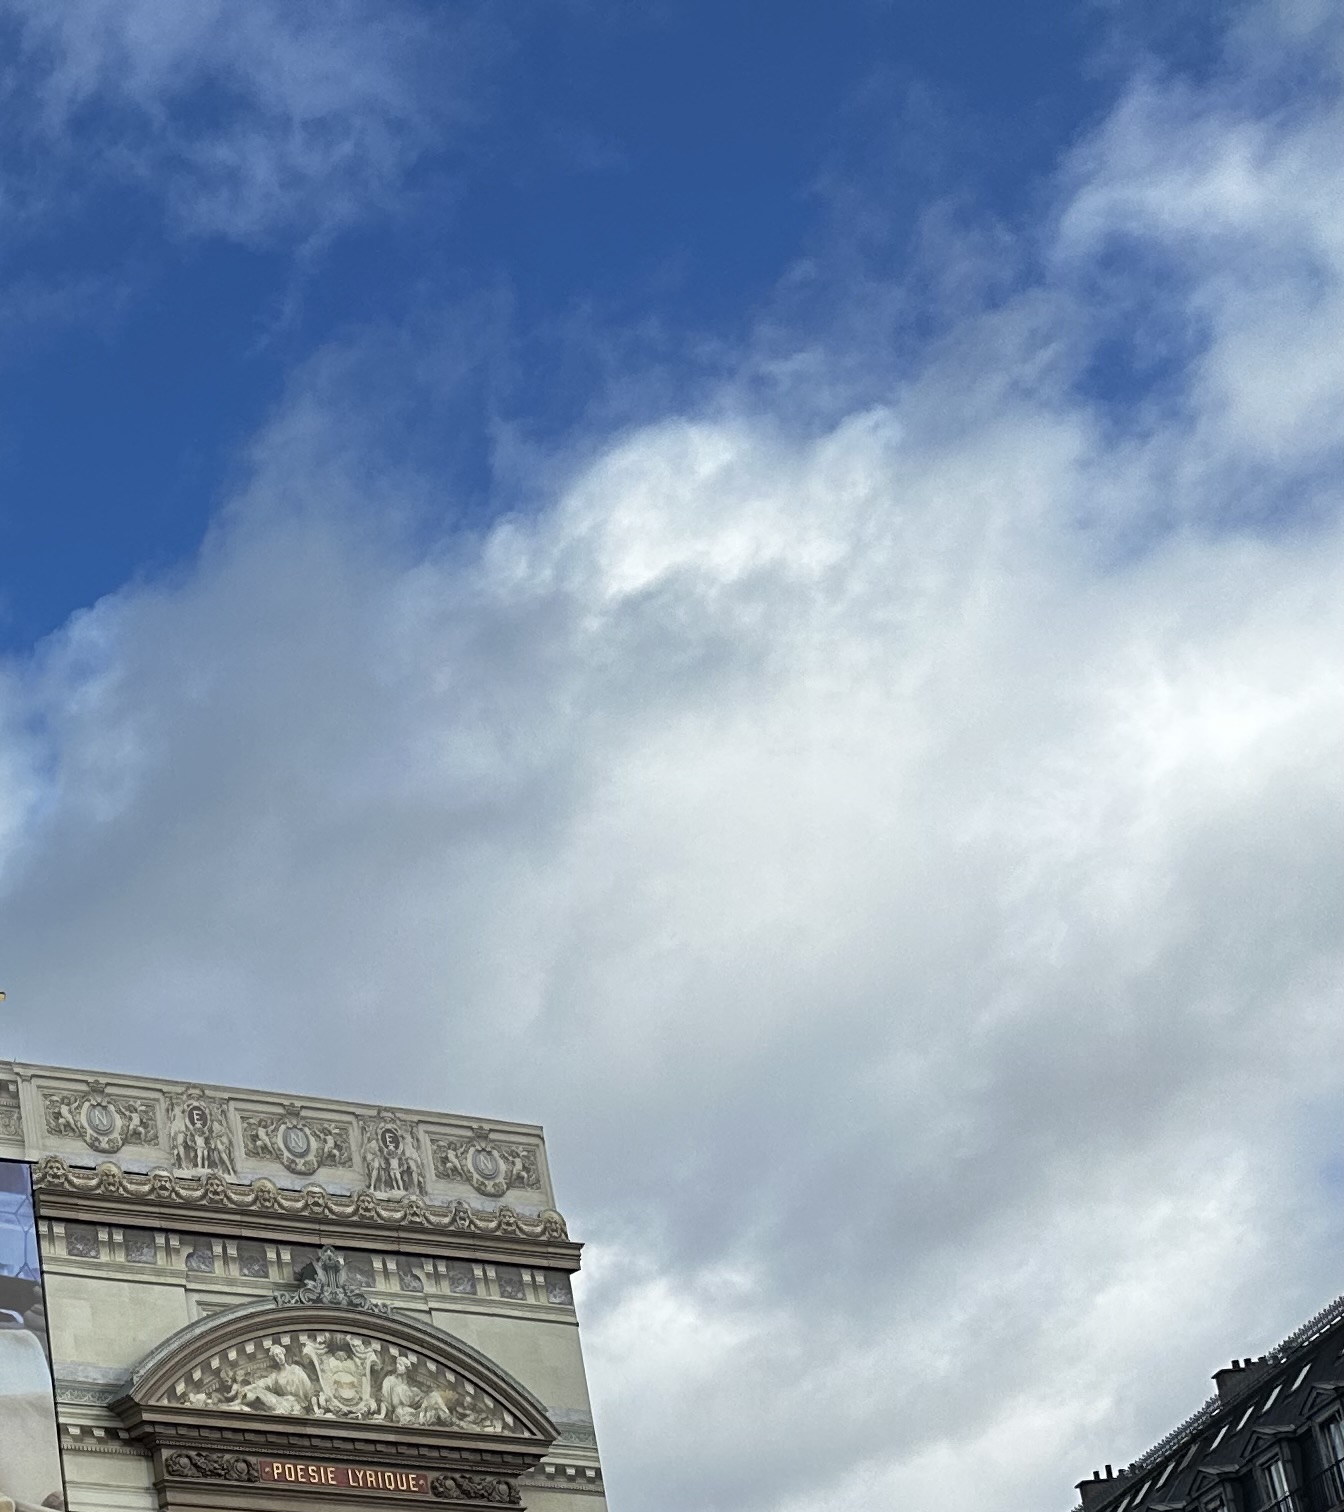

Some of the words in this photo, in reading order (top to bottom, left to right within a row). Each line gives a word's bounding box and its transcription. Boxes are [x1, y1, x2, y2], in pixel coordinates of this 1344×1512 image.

[93, 1108, 110, 1130] N
[193, 1109, 204, 1124] E
[290, 1133, 303, 1153] N
[386, 1133, 395, 1147] E
[480, 1156, 493, 1173] N
[273, 1463, 337, 1485] POESIE
[348, 1468, 419, 1491] LYRIQUE
